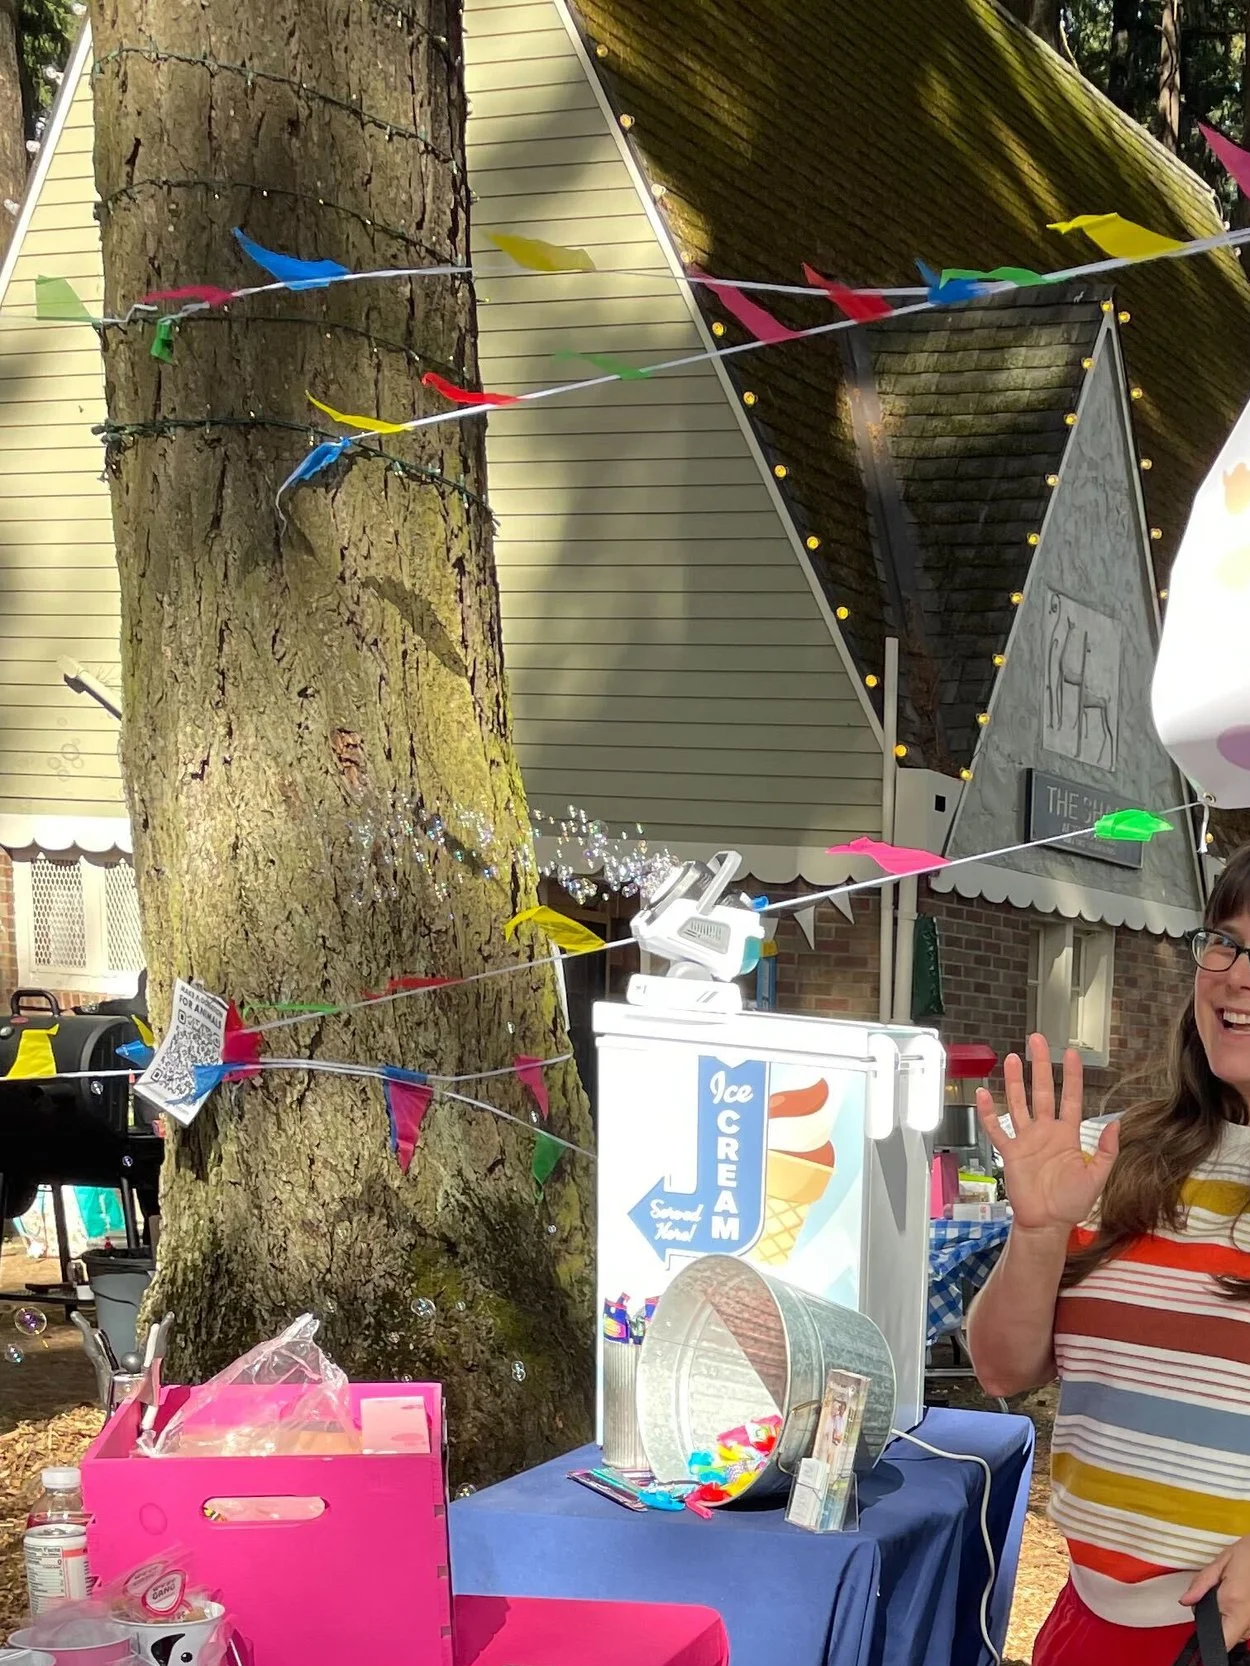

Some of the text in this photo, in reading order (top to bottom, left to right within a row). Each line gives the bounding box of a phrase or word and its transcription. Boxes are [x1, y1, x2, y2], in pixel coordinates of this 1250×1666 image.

[1047, 785, 1079, 820] THE
[179, 994, 194, 1010] FOR
[710, 1070, 753, 1104] Ice
[711, 1109, 741, 1241] CREAM
